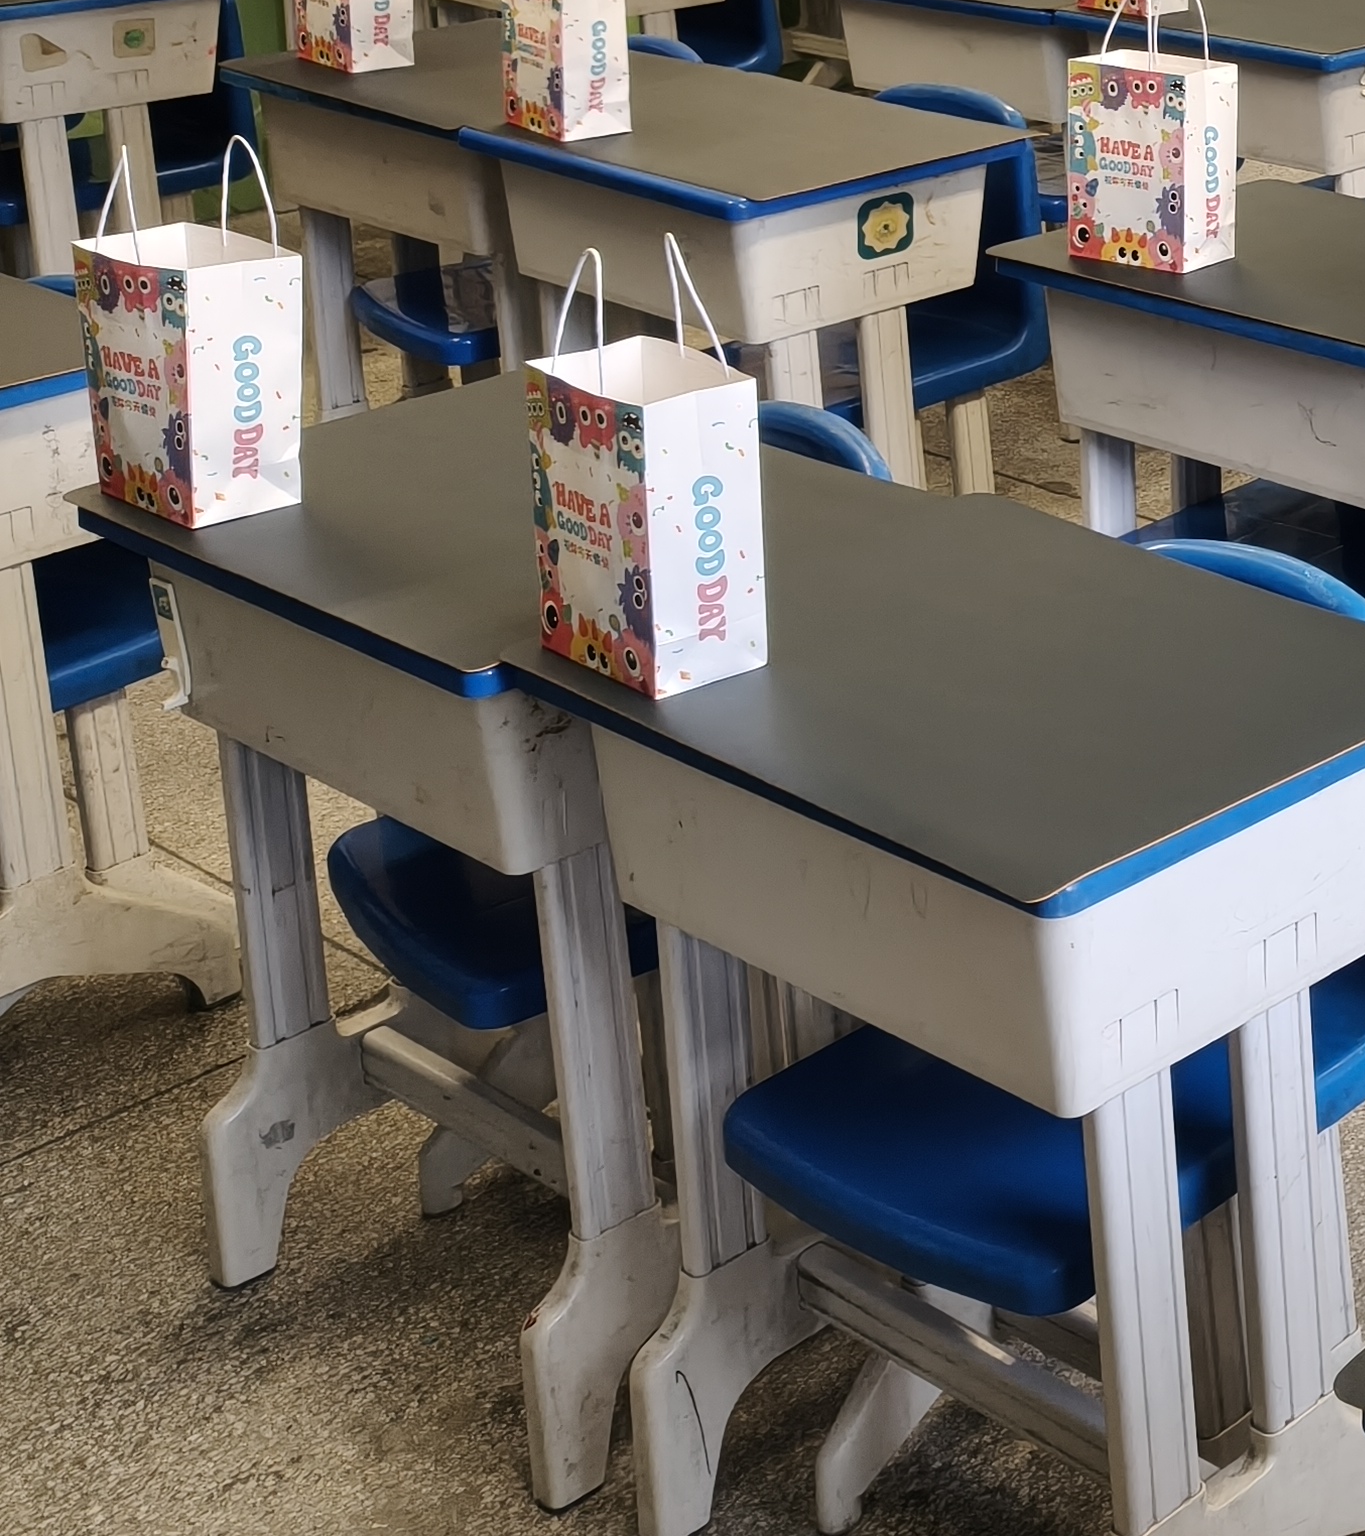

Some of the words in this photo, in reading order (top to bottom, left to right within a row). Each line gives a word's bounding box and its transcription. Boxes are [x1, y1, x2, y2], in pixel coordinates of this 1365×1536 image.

[591, 20, 607, 76] GOOD
[1100, 137, 1141, 160] HAVE
[1144, 145, 1154, 161] A
[1204, 126, 1219, 193] GOOD
[102, 346, 145, 377] HAVE
[148, 358, 159, 380] A
[233, 335, 262, 423] GOOD
[232, 423, 264, 479] DAY
[555, 481, 595, 522] HAVE
[600, 502, 611, 528] A
[692, 476, 725, 576] GOOD
[698, 575, 728, 642] DAY
